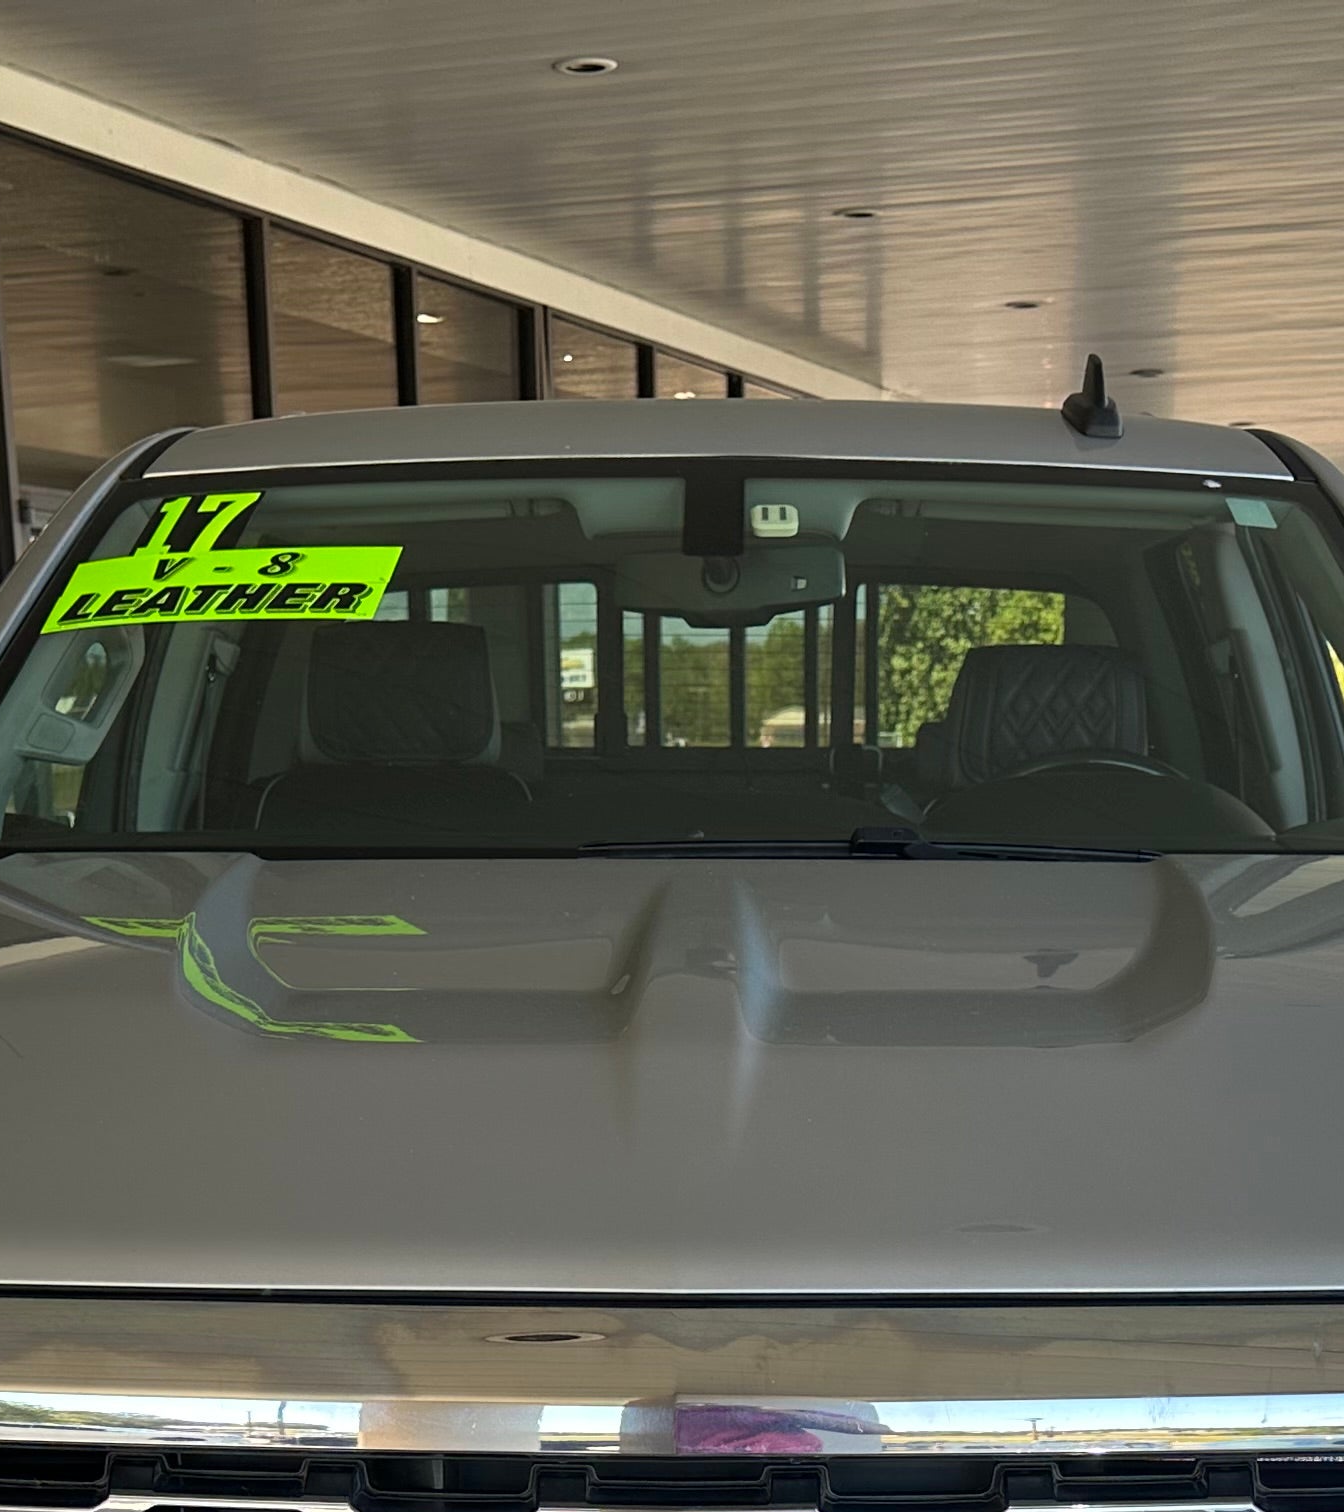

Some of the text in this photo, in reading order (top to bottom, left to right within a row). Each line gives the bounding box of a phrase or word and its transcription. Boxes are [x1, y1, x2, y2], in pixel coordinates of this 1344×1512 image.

[130, 491, 265, 556] 17
[258, 551, 306, 578] 8
[58, 582, 374, 626] LEATHER
